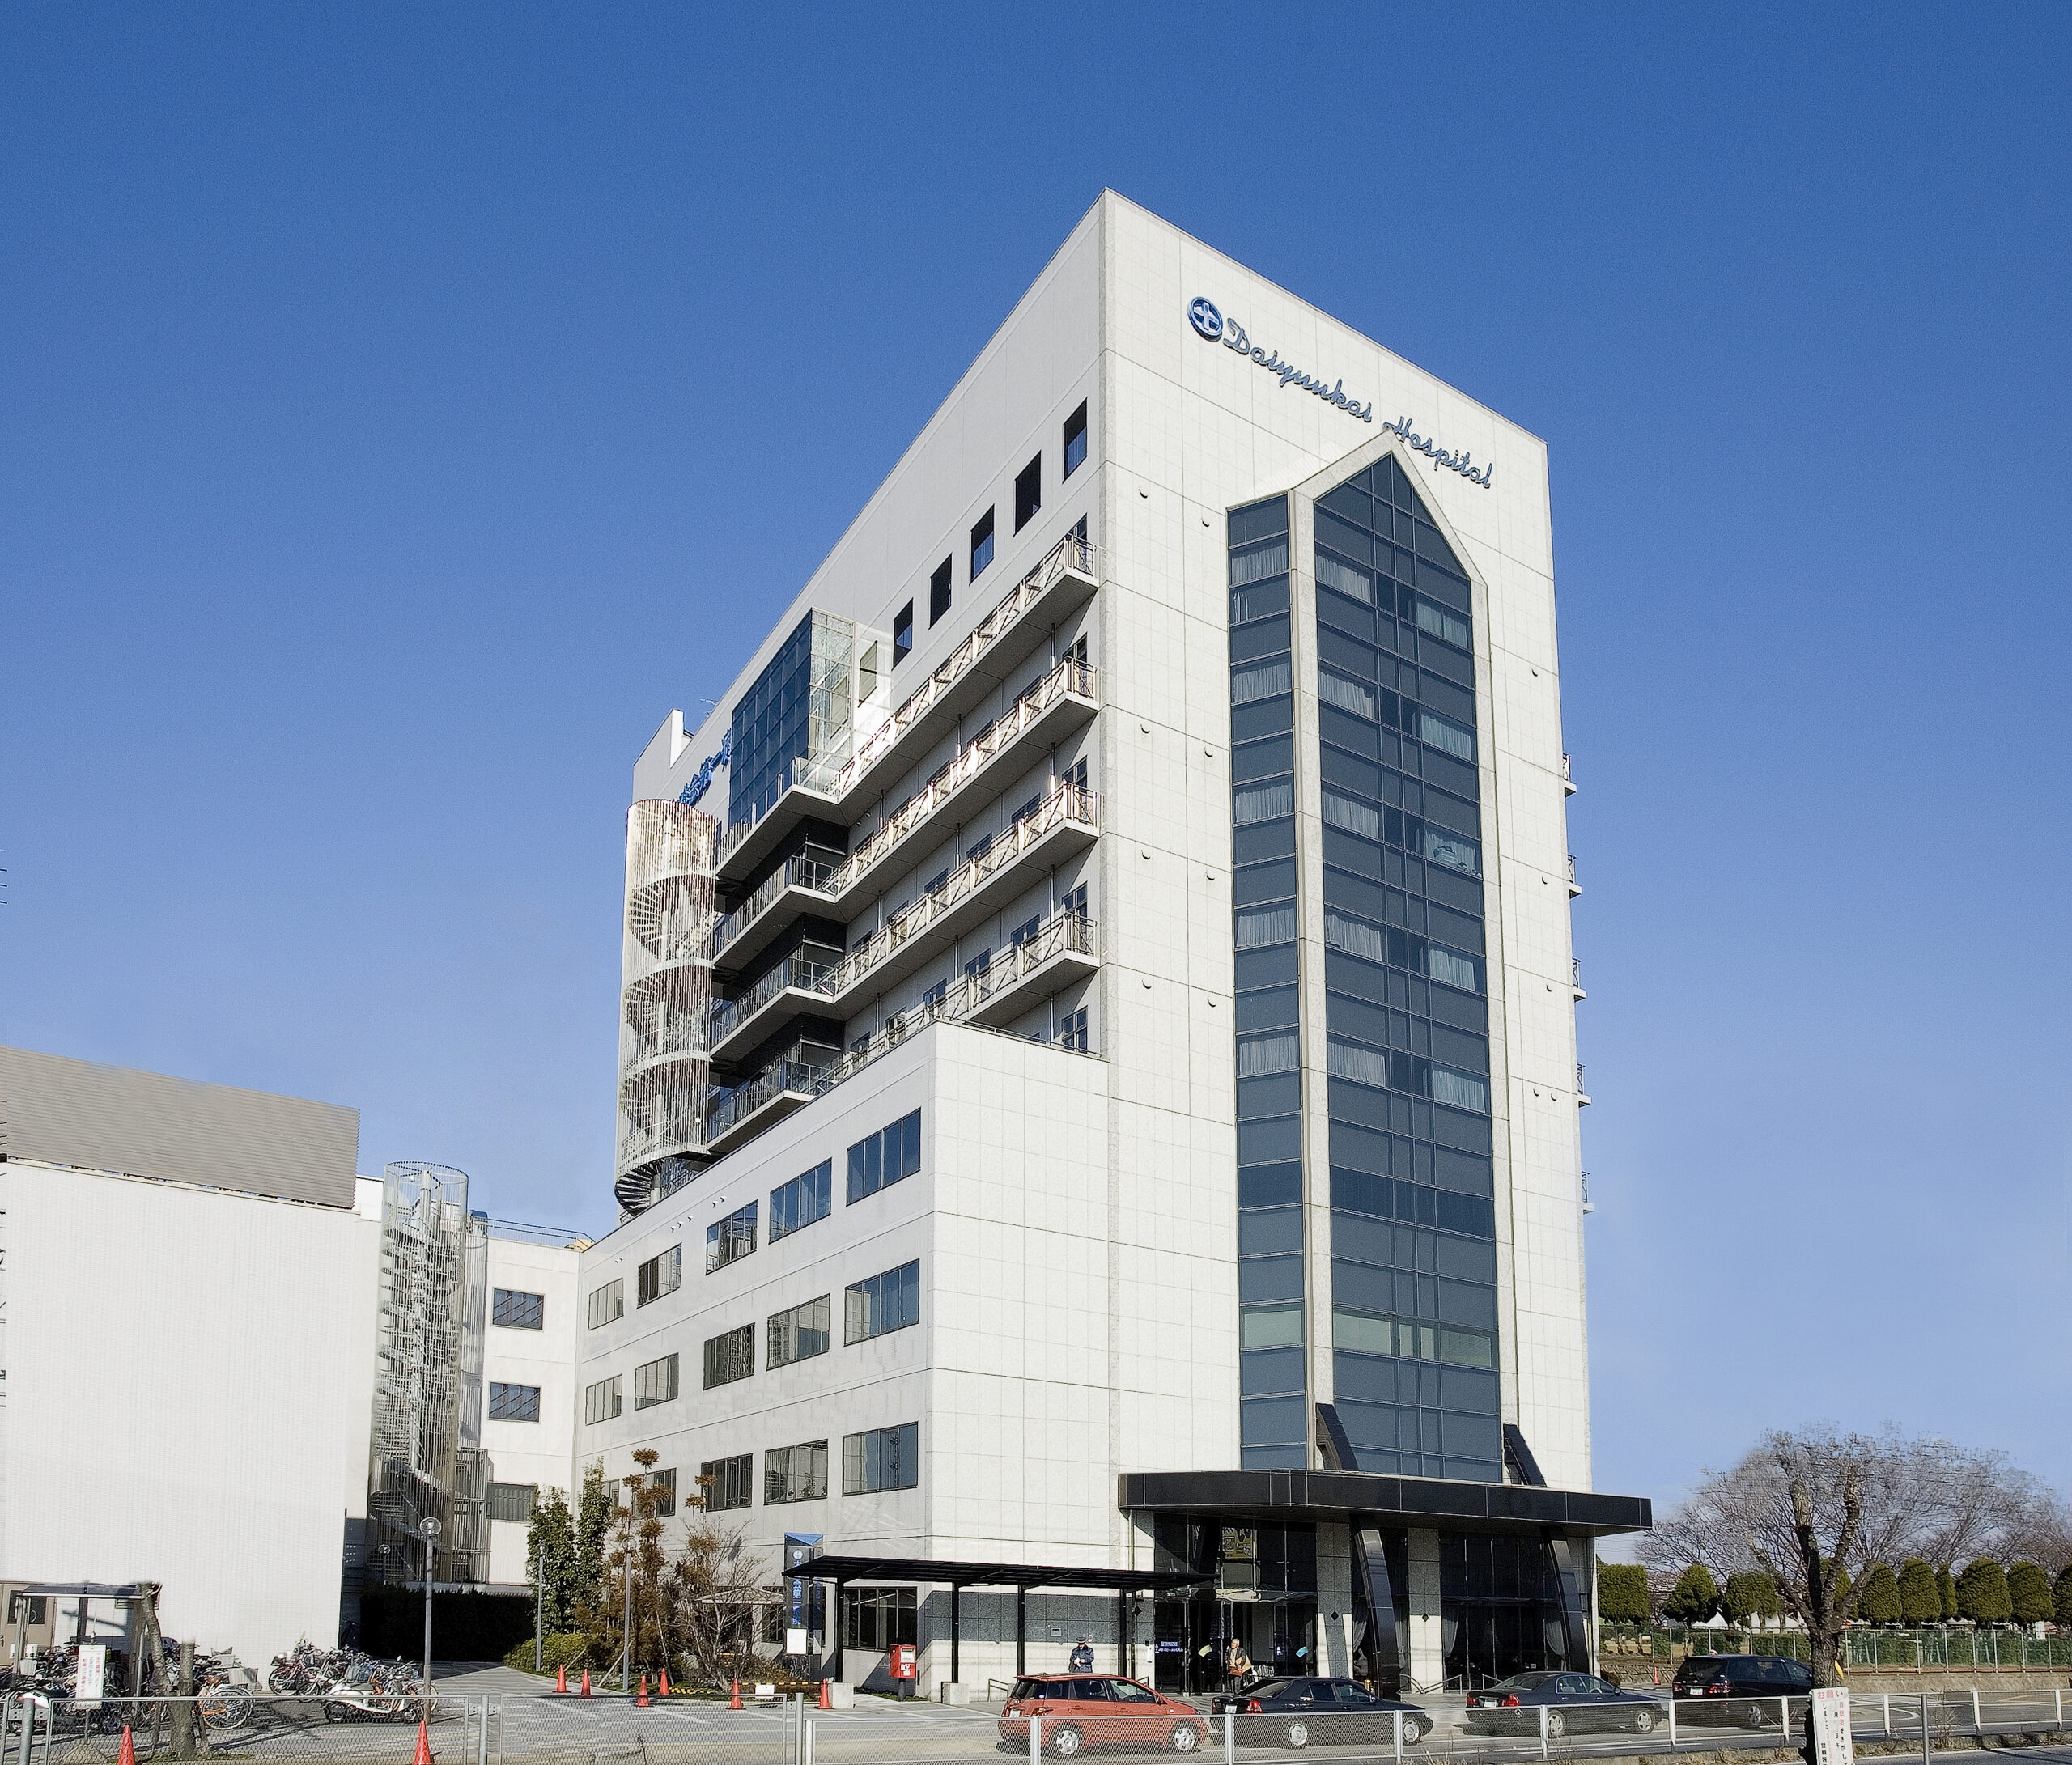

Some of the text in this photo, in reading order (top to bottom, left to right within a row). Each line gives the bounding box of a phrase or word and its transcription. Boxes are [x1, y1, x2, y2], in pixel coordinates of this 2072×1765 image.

[1223, 317, 1492, 489] Daiyuukai Hospital
[1818, 1690, 1843, 1699] お願い
